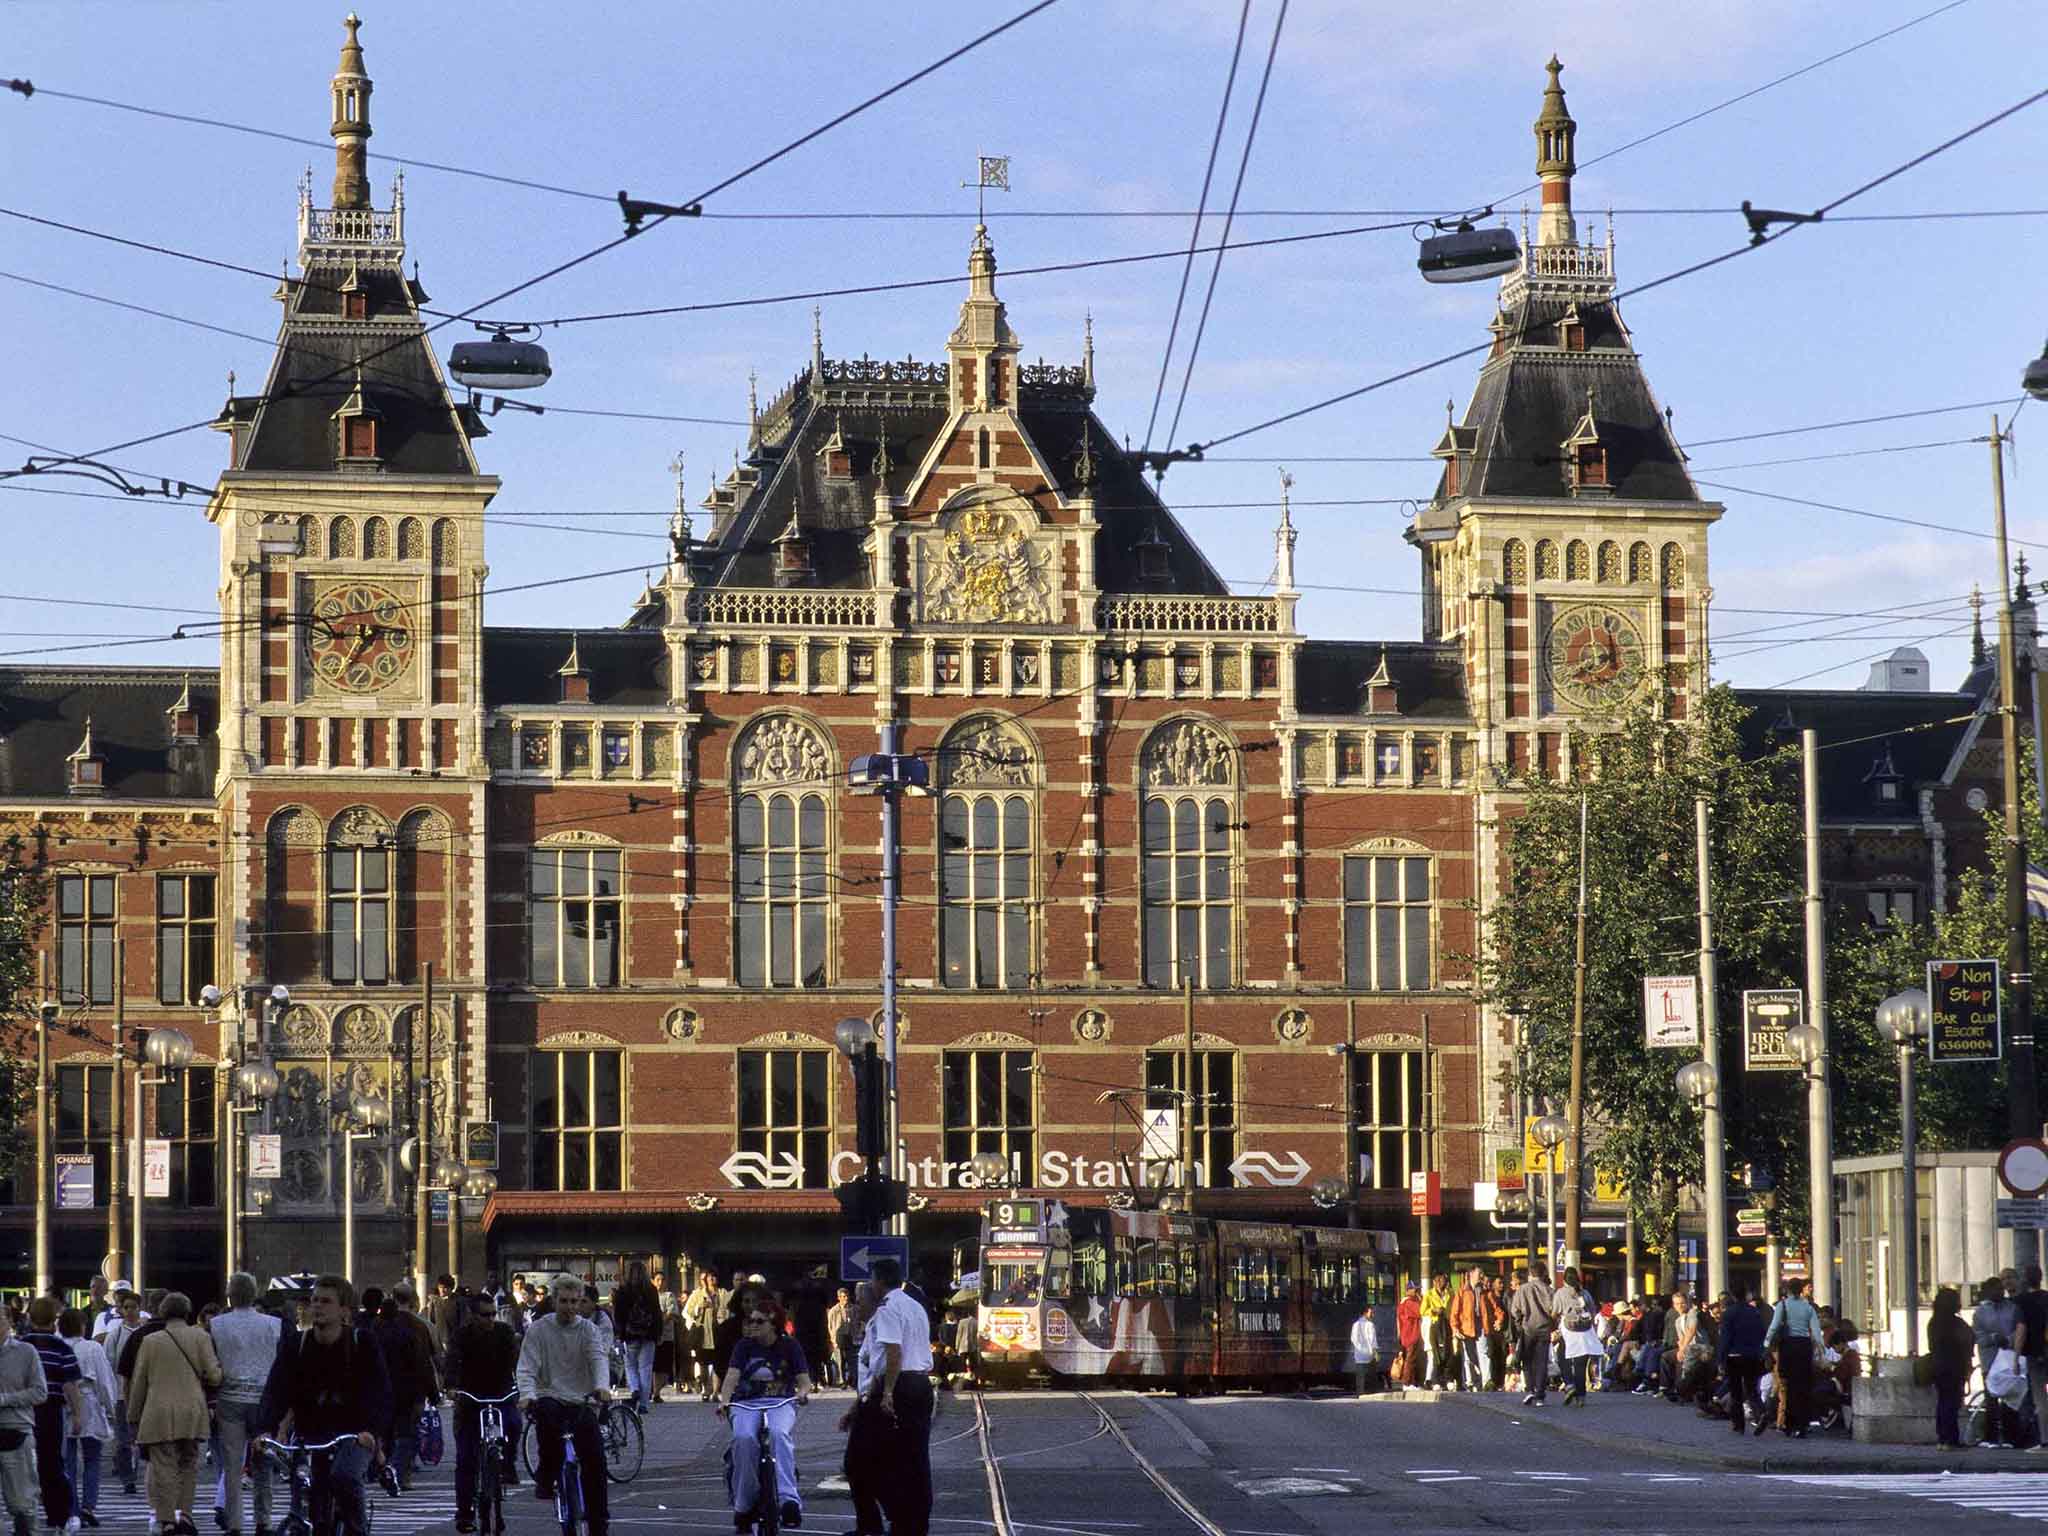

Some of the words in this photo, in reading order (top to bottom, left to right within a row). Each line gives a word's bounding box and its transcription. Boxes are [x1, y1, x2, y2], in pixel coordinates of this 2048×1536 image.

[351, 591, 368, 610] N
[1962, 967, 1992, 983] Non
[1752, 1032, 1789, 1044] IRIS
[1944, 1026, 1985, 1037] ESCORT
[56, 1155, 93, 1165] CHANGE
[999, 1204, 1014, 1224] 9
[1238, 1312, 1264, 1331] THINK
[1266, 1312, 1281, 1331] BIG
